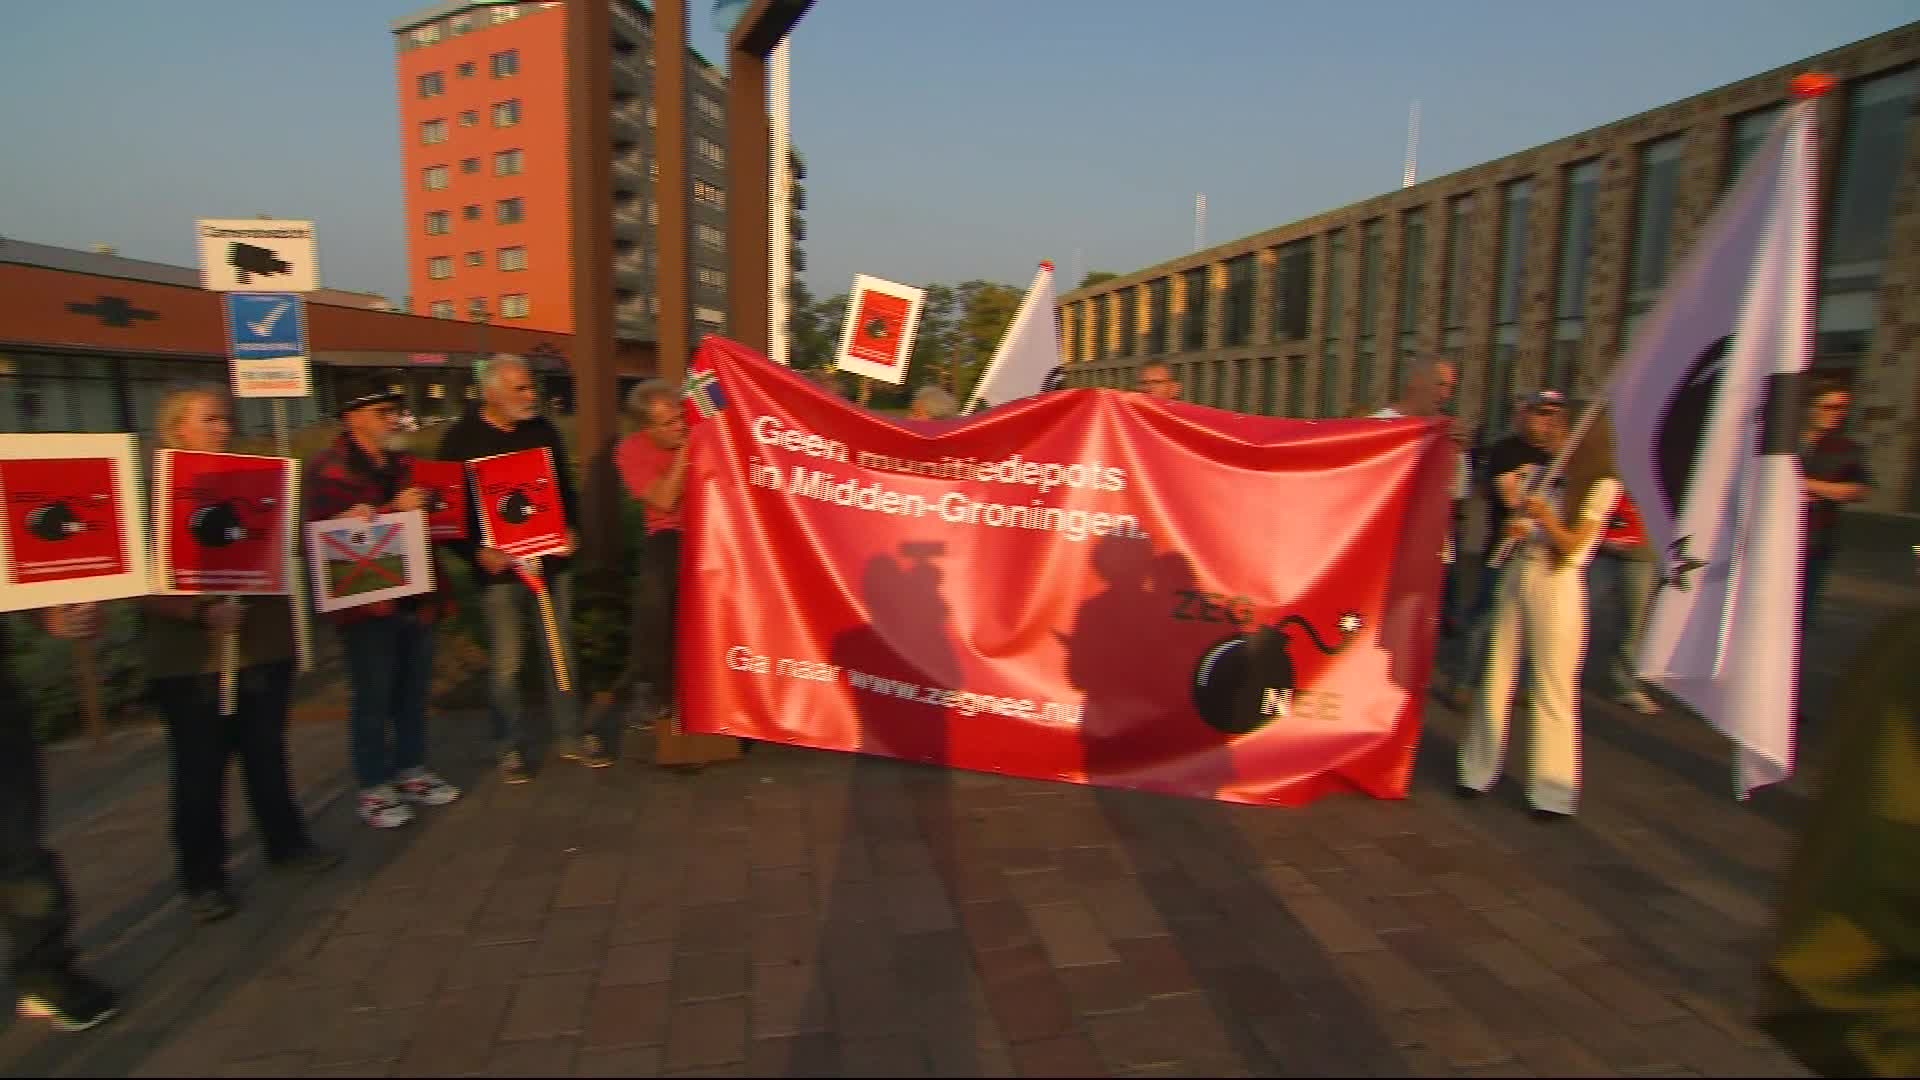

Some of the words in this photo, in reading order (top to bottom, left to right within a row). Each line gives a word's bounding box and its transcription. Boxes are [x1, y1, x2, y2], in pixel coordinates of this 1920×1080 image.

[751, 415, 848, 463] Geen
[856, 449, 1126, 493] munitiedepots
[748, 456, 783, 490] in
[789, 466, 1149, 542] Midden-Groningen.
[1172, 591, 1256, 626] ZEG
[725, 646, 770, 674] Ga
[776, 657, 842, 683] naar
[847, 668, 1083, 725] www.zegnee.nu
[1260, 687, 1344, 720] NEE
